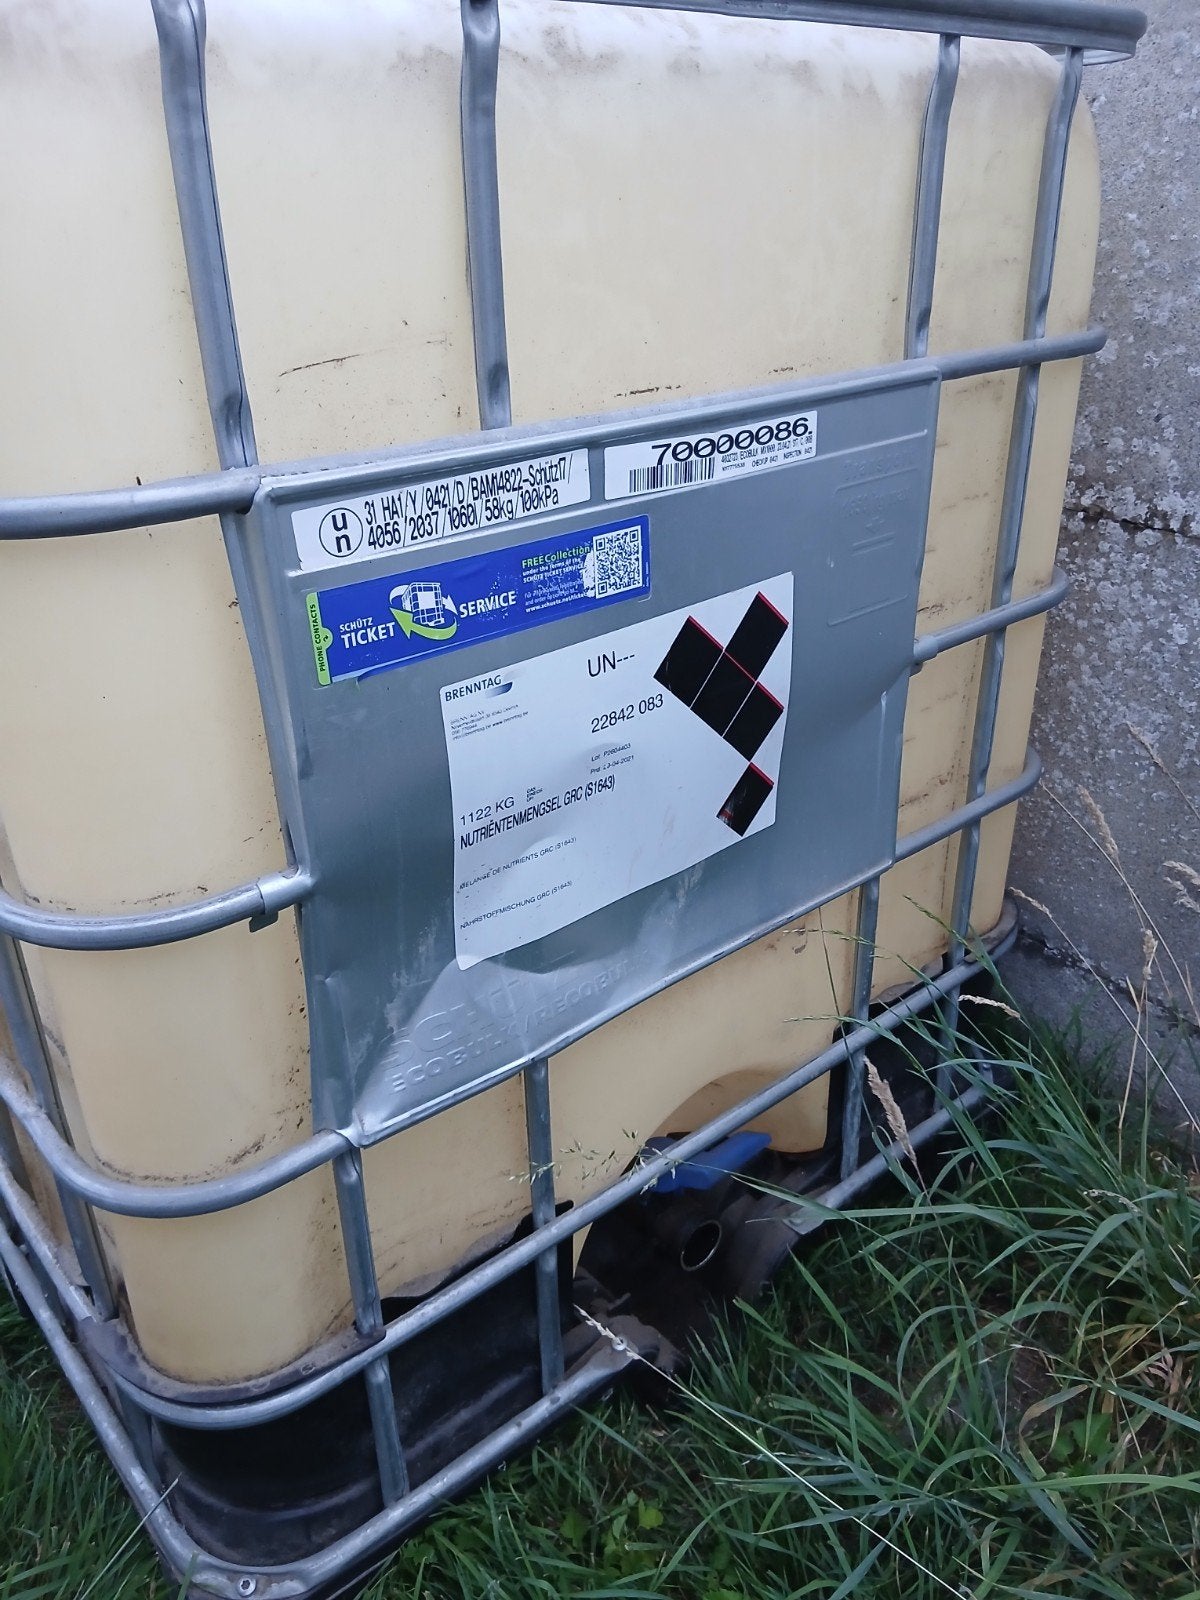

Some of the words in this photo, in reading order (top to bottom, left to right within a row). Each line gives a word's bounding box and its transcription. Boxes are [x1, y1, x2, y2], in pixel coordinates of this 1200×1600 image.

[460, 590, 517, 619] SERVICE
[309, 604, 322, 644] CONTACTS
[339, 617, 373, 633] SCHÜTZ
[341, 621, 395, 649] TICKET
[316, 646, 326, 672] PHONE
[445, 674, 501, 702] BRENNTAG
[591, 704, 635, 734] 22842
[638, 693, 664, 716] 083
[563, 786, 583, 807] GRC
[584, 774, 615, 801] (S1643)
[460, 805, 492, 826] 1122
[495, 796, 515, 814] KG
[492, 866, 501, 876] DE
[502, 853, 538, 871] NUTRIENTS
[540, 845, 554, 857] GRC
[536, 890, 550, 901] GRC
